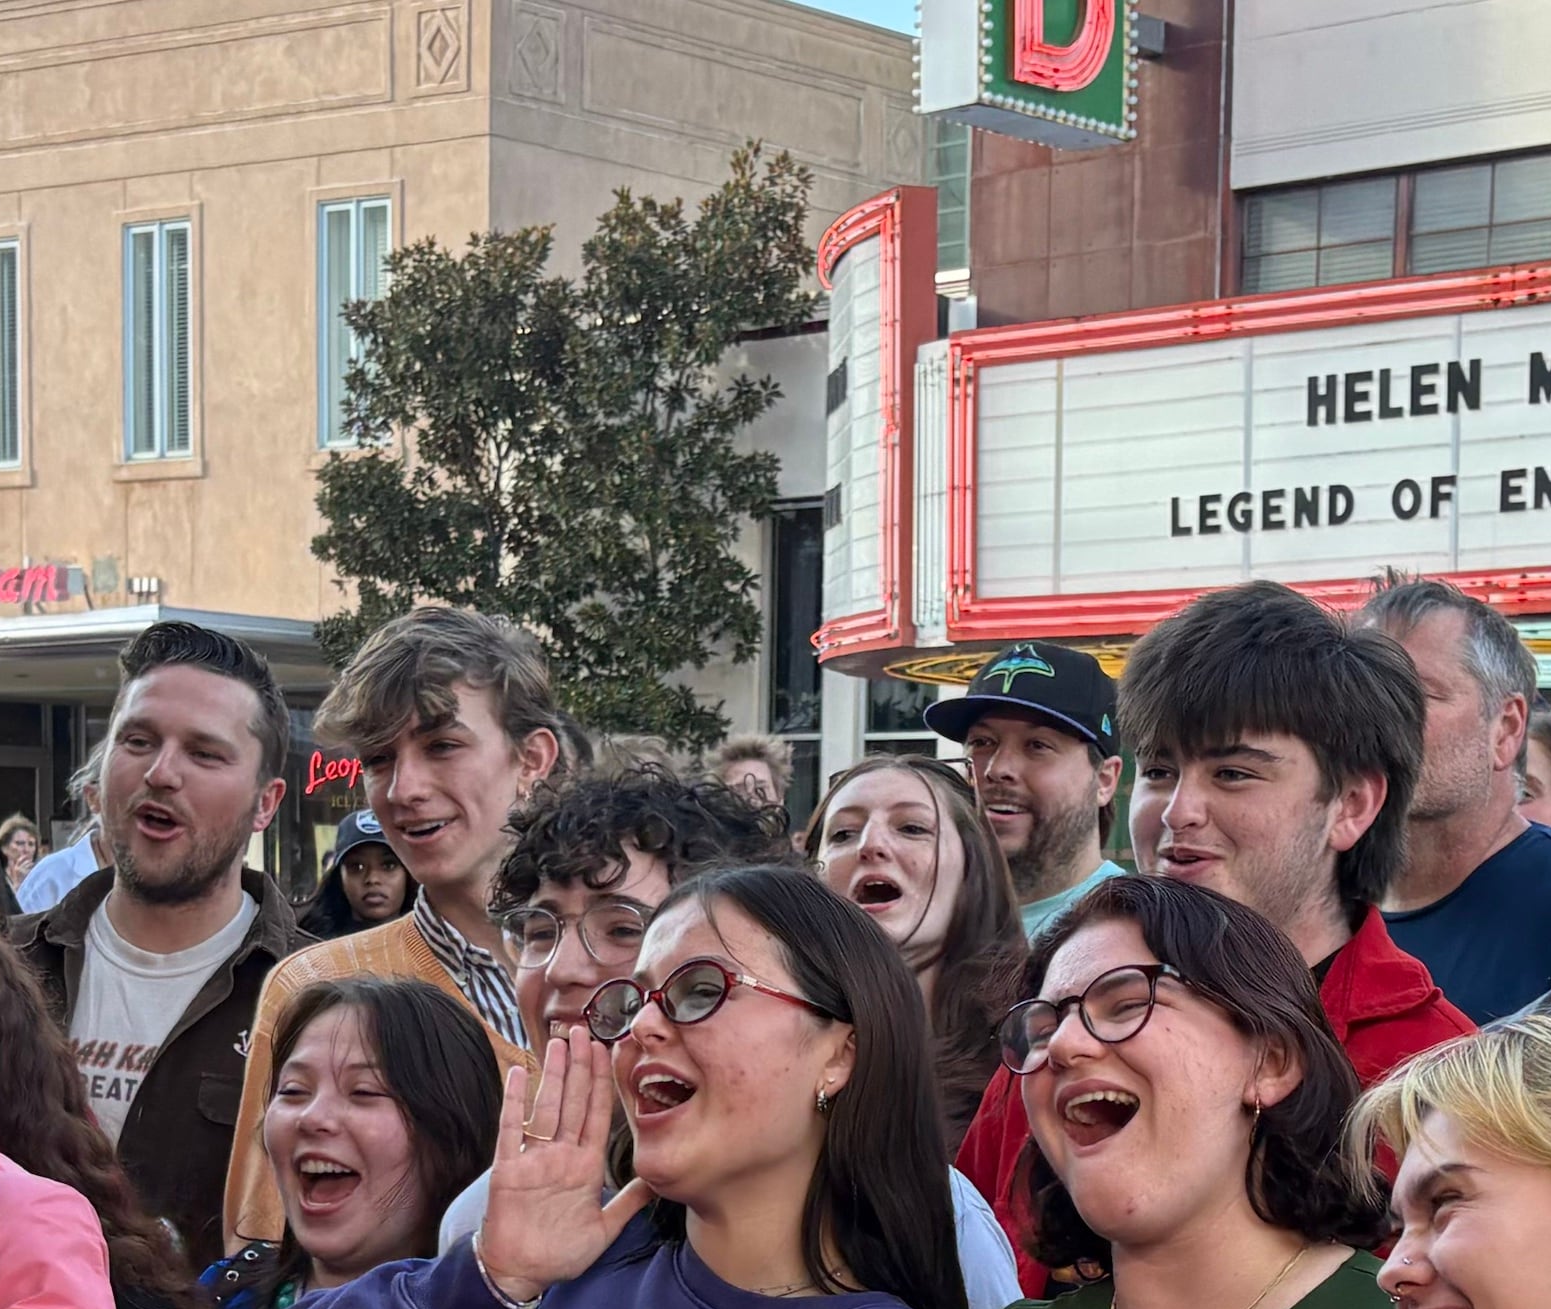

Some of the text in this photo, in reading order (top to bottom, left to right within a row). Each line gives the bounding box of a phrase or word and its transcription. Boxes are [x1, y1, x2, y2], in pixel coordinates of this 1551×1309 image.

[1307, 358, 1482, 427] HELEN
[1171, 484, 1354, 537] LEGEND
[1392, 475, 1457, 519] OF
[304, 750, 364, 795] Leop
